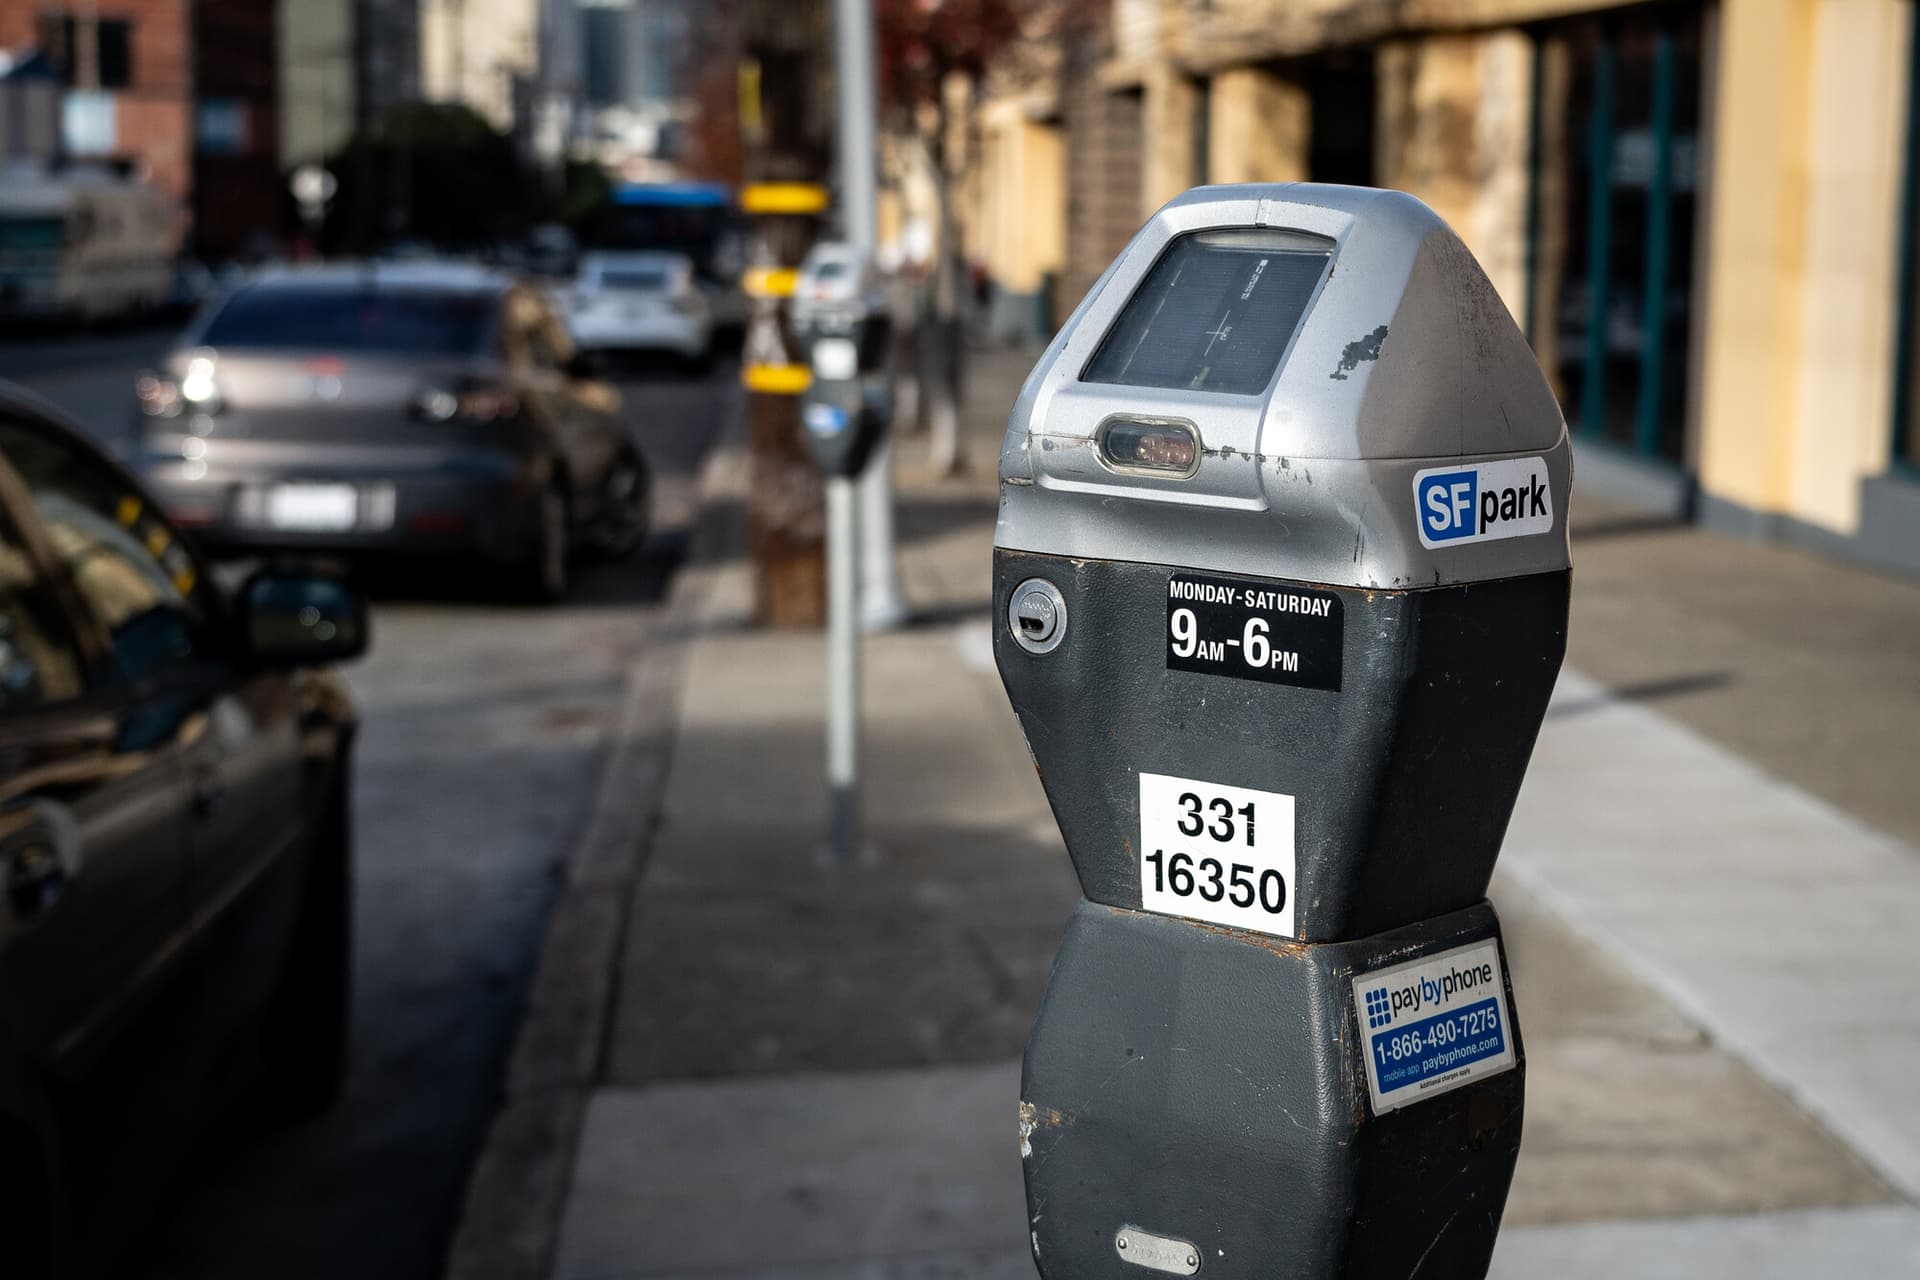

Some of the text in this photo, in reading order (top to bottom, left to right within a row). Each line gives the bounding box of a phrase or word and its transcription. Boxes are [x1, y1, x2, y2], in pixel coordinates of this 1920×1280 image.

[1426, 474, 1547, 535] SF park
[1169, 580, 1332, 617] MONDAY-SATURDAY
[1177, 792, 1255, 847] 331
[1145, 849, 1287, 915] 16350
[1391, 963, 1493, 1018] paybyphone
[1377, 1006, 1497, 1065] 1-866-490-7275
[1383, 1036, 1499, 1083] mobile app paybyphone.com
